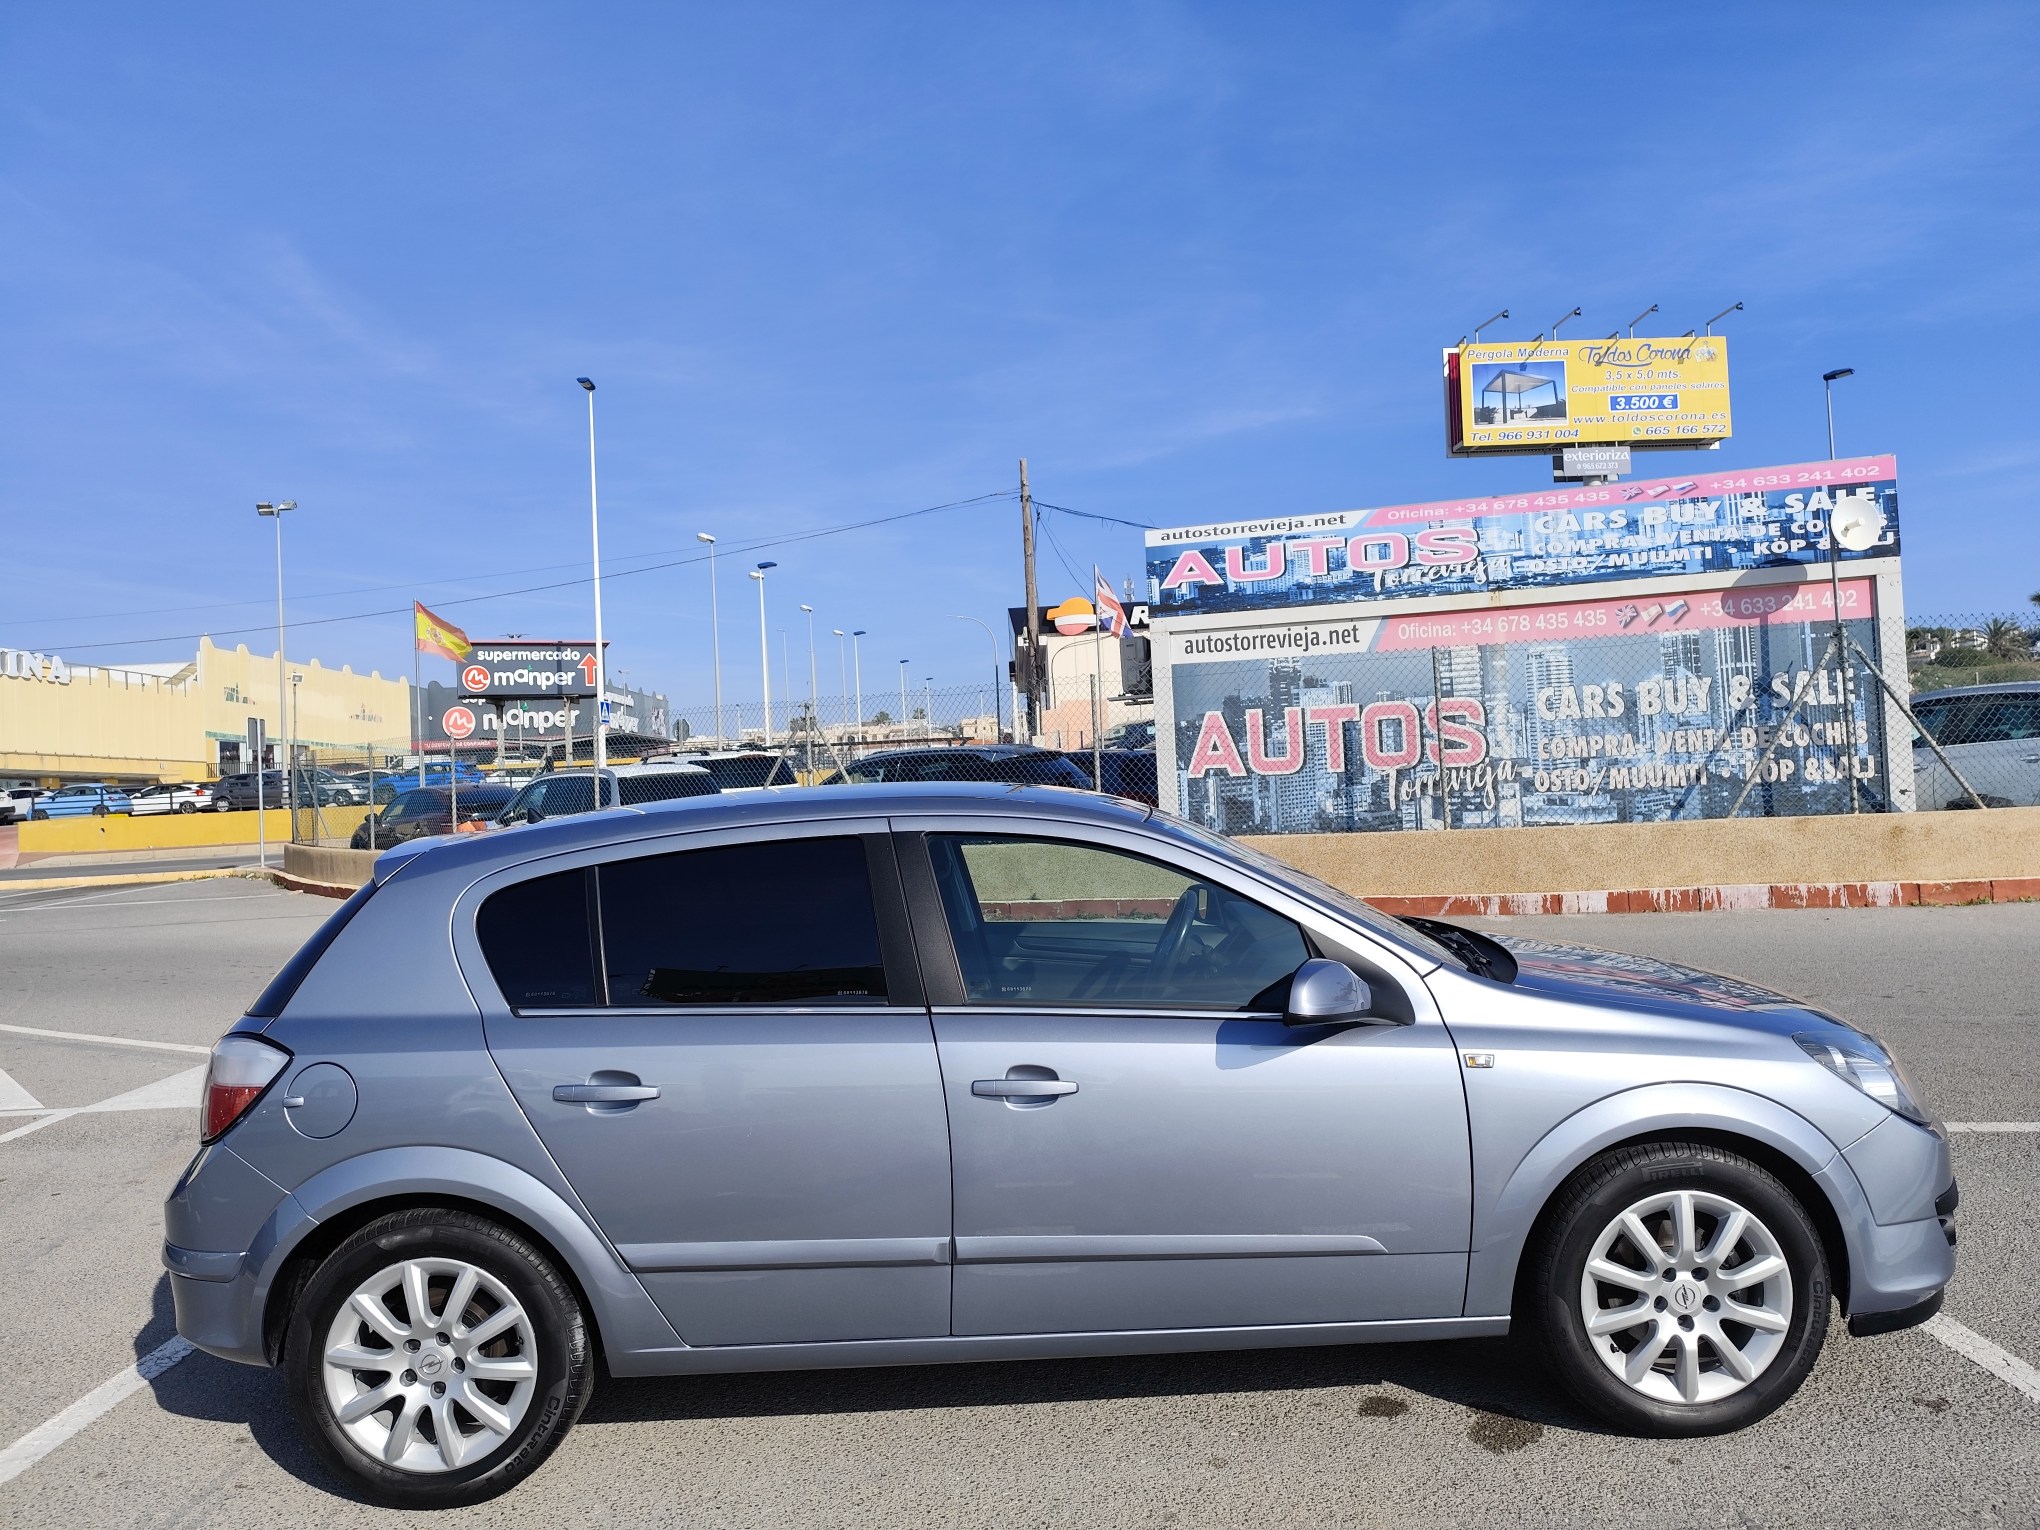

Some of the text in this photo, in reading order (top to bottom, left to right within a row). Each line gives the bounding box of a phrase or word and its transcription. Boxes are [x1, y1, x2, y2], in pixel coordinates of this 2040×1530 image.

[1517, 348, 1569, 358] Moderna
[1578, 343, 1692, 367] Toldos Corona
[1571, 384, 1626, 393] Compatible
[1650, 382, 1687, 392] paneles
[1690, 381, 1725, 389] solares
[1605, 370, 1622, 381] 3,5
[1636, 370, 1654, 380] 5,0
[1615, 395, 1674, 410] 3.500 €
[1573, 411, 1727, 424] www.toldoscorona.es
[1645, 424, 1727, 435] 665 166 572
[1470, 428, 1580, 442] Tel. 966 931 004
[1563, 449, 1630, 462] exterioriza
[1710, 465, 1880, 490] +34 633 241 402
[1387, 491, 1610, 521] Oficina: +34 678 435 435
[1534, 508, 1628, 535] CARS
[1644, 500, 1721, 526] BUY
[1740, 497, 1768, 518] &
[1160, 513, 1347, 541] autostorrevieja.net
[1534, 535, 1640, 556] COMPRA
[1660, 526, 1744, 546] VENTA
[1750, 521, 1782, 537] DE
[1160, 527, 1479, 590] AUTOS
[1700, 599, 1736, 617] +34
[1740, 596, 1777, 615] 633
[1781, 593, 1817, 611] 241
[1398, 609, 1607, 640] Oficina: +34 678 435 435
[1184, 624, 1360, 655] autostorrevieja.net
[477, 647, 581, 664] supermercado
[493, 668, 576, 691] manper
[1536, 667, 1856, 720] CARS BUY & SALE
[482, 708, 580, 735] manper
[1187, 697, 1489, 779] AUTOS
[1538, 733, 1637, 760] COMPRA
[1658, 728, 1733, 756] VENTA
[1740, 726, 1774, 749] DE
